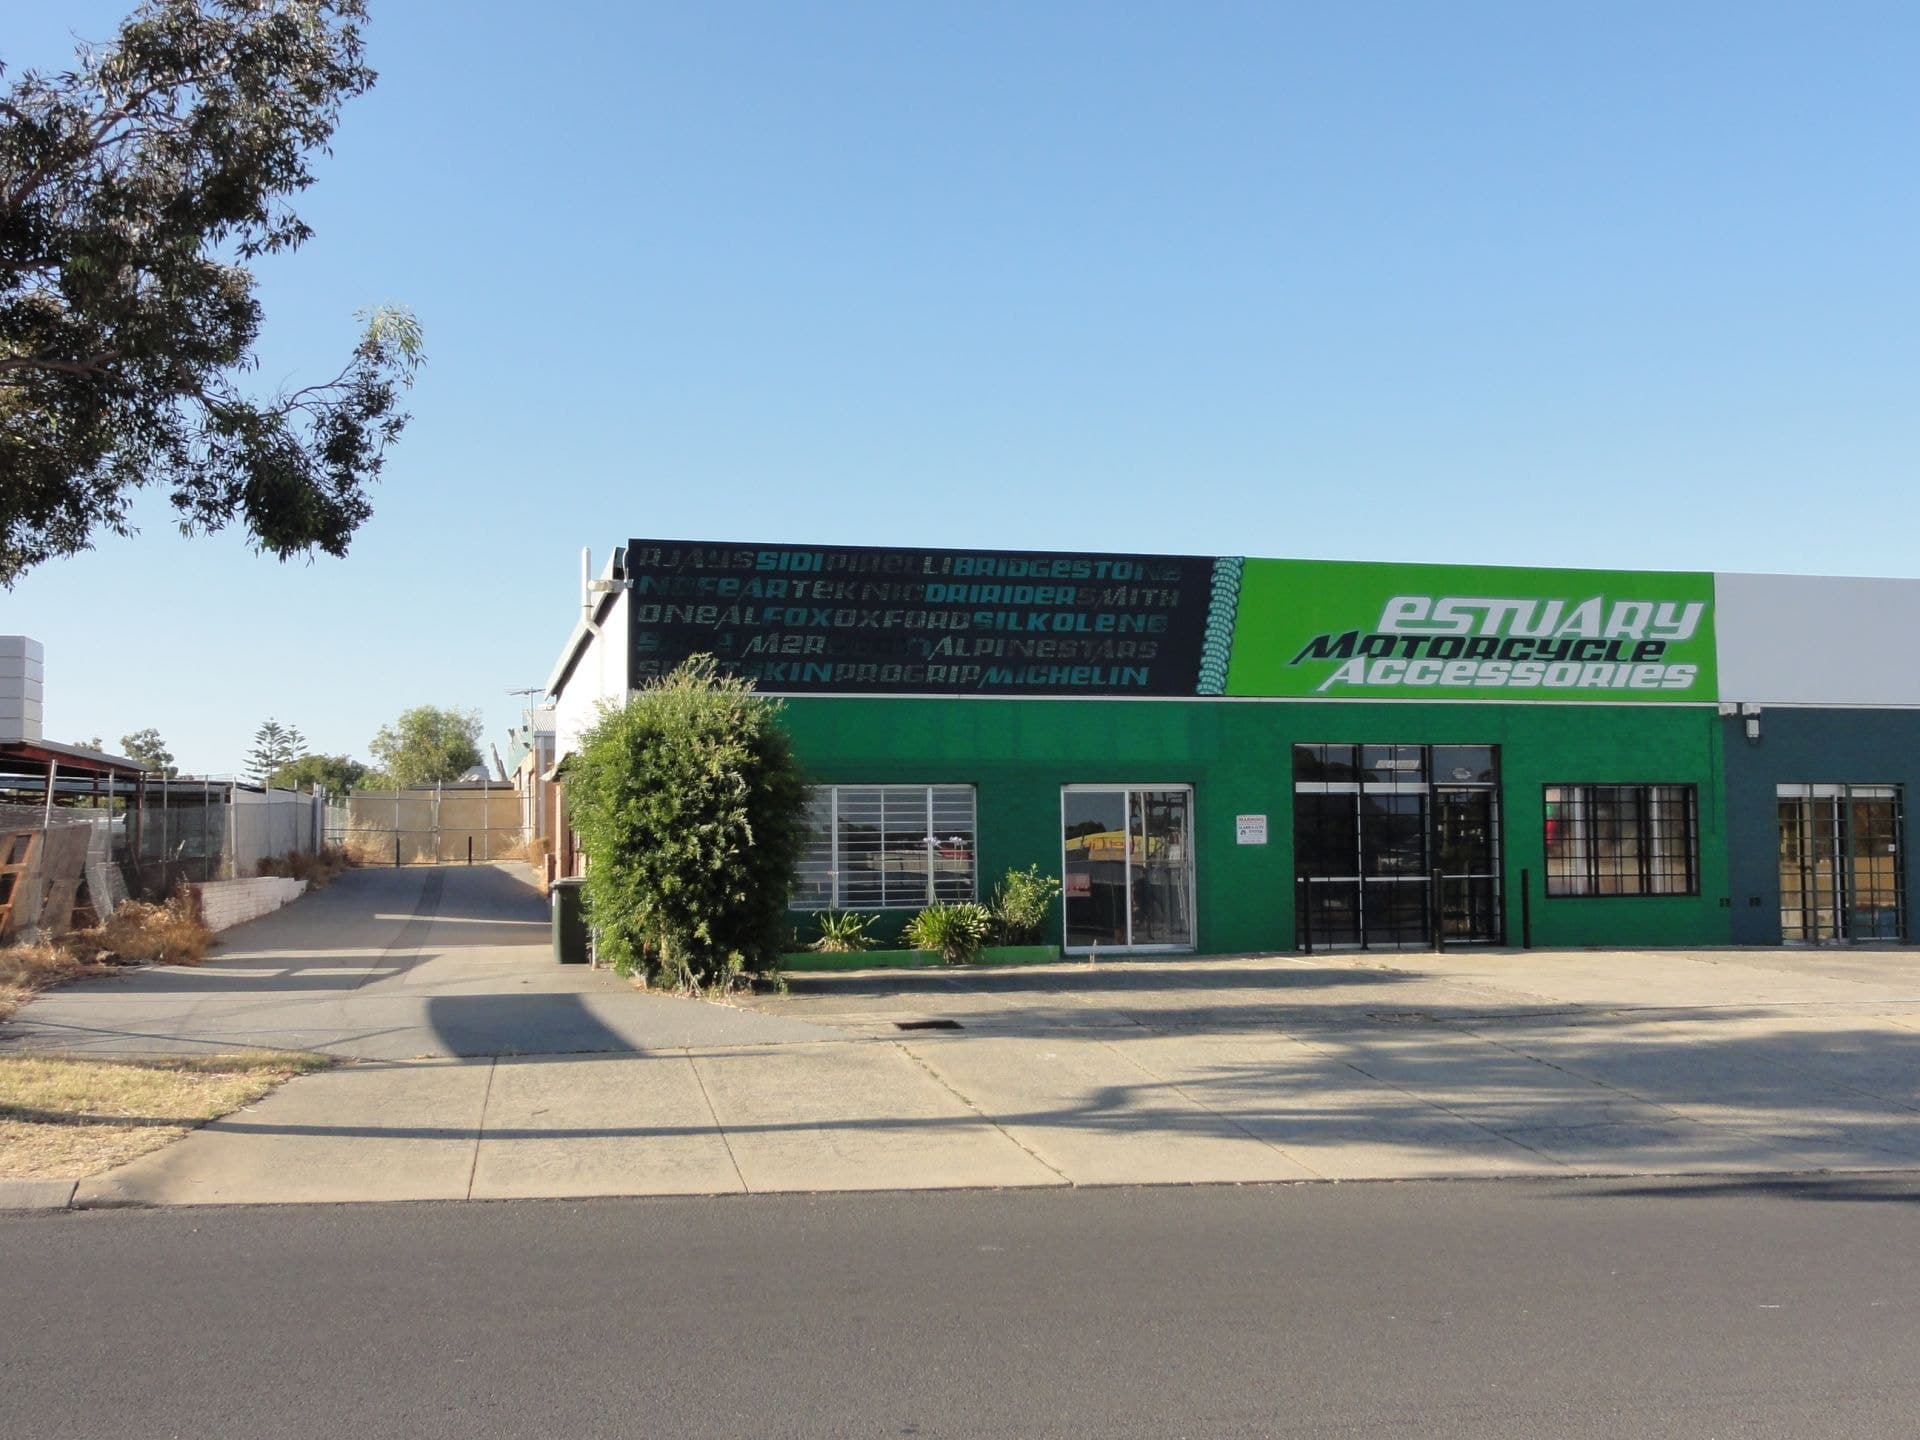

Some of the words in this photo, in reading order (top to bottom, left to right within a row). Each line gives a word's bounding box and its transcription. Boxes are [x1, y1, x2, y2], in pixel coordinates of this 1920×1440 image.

[755, 551, 824, 572] SIDI
[953, 557, 1181, 582] BRIDGESTONE
[925, 583, 1077, 606] DRIRIDER
[638, 604, 761, 630] ONEAL
[761, 607, 830, 628] FOX
[833, 608, 970, 630] OXFORD
[972, 611, 1168, 634] SILKOLENE
[1377, 595, 1704, 639] ESTUARY
[743, 632, 827, 658] M2R
[1290, 631, 1666, 665] MOTORCYCLE
[977, 665, 1150, 688] MICHELIN
[1318, 657, 1697, 691] ACCESSORIES
